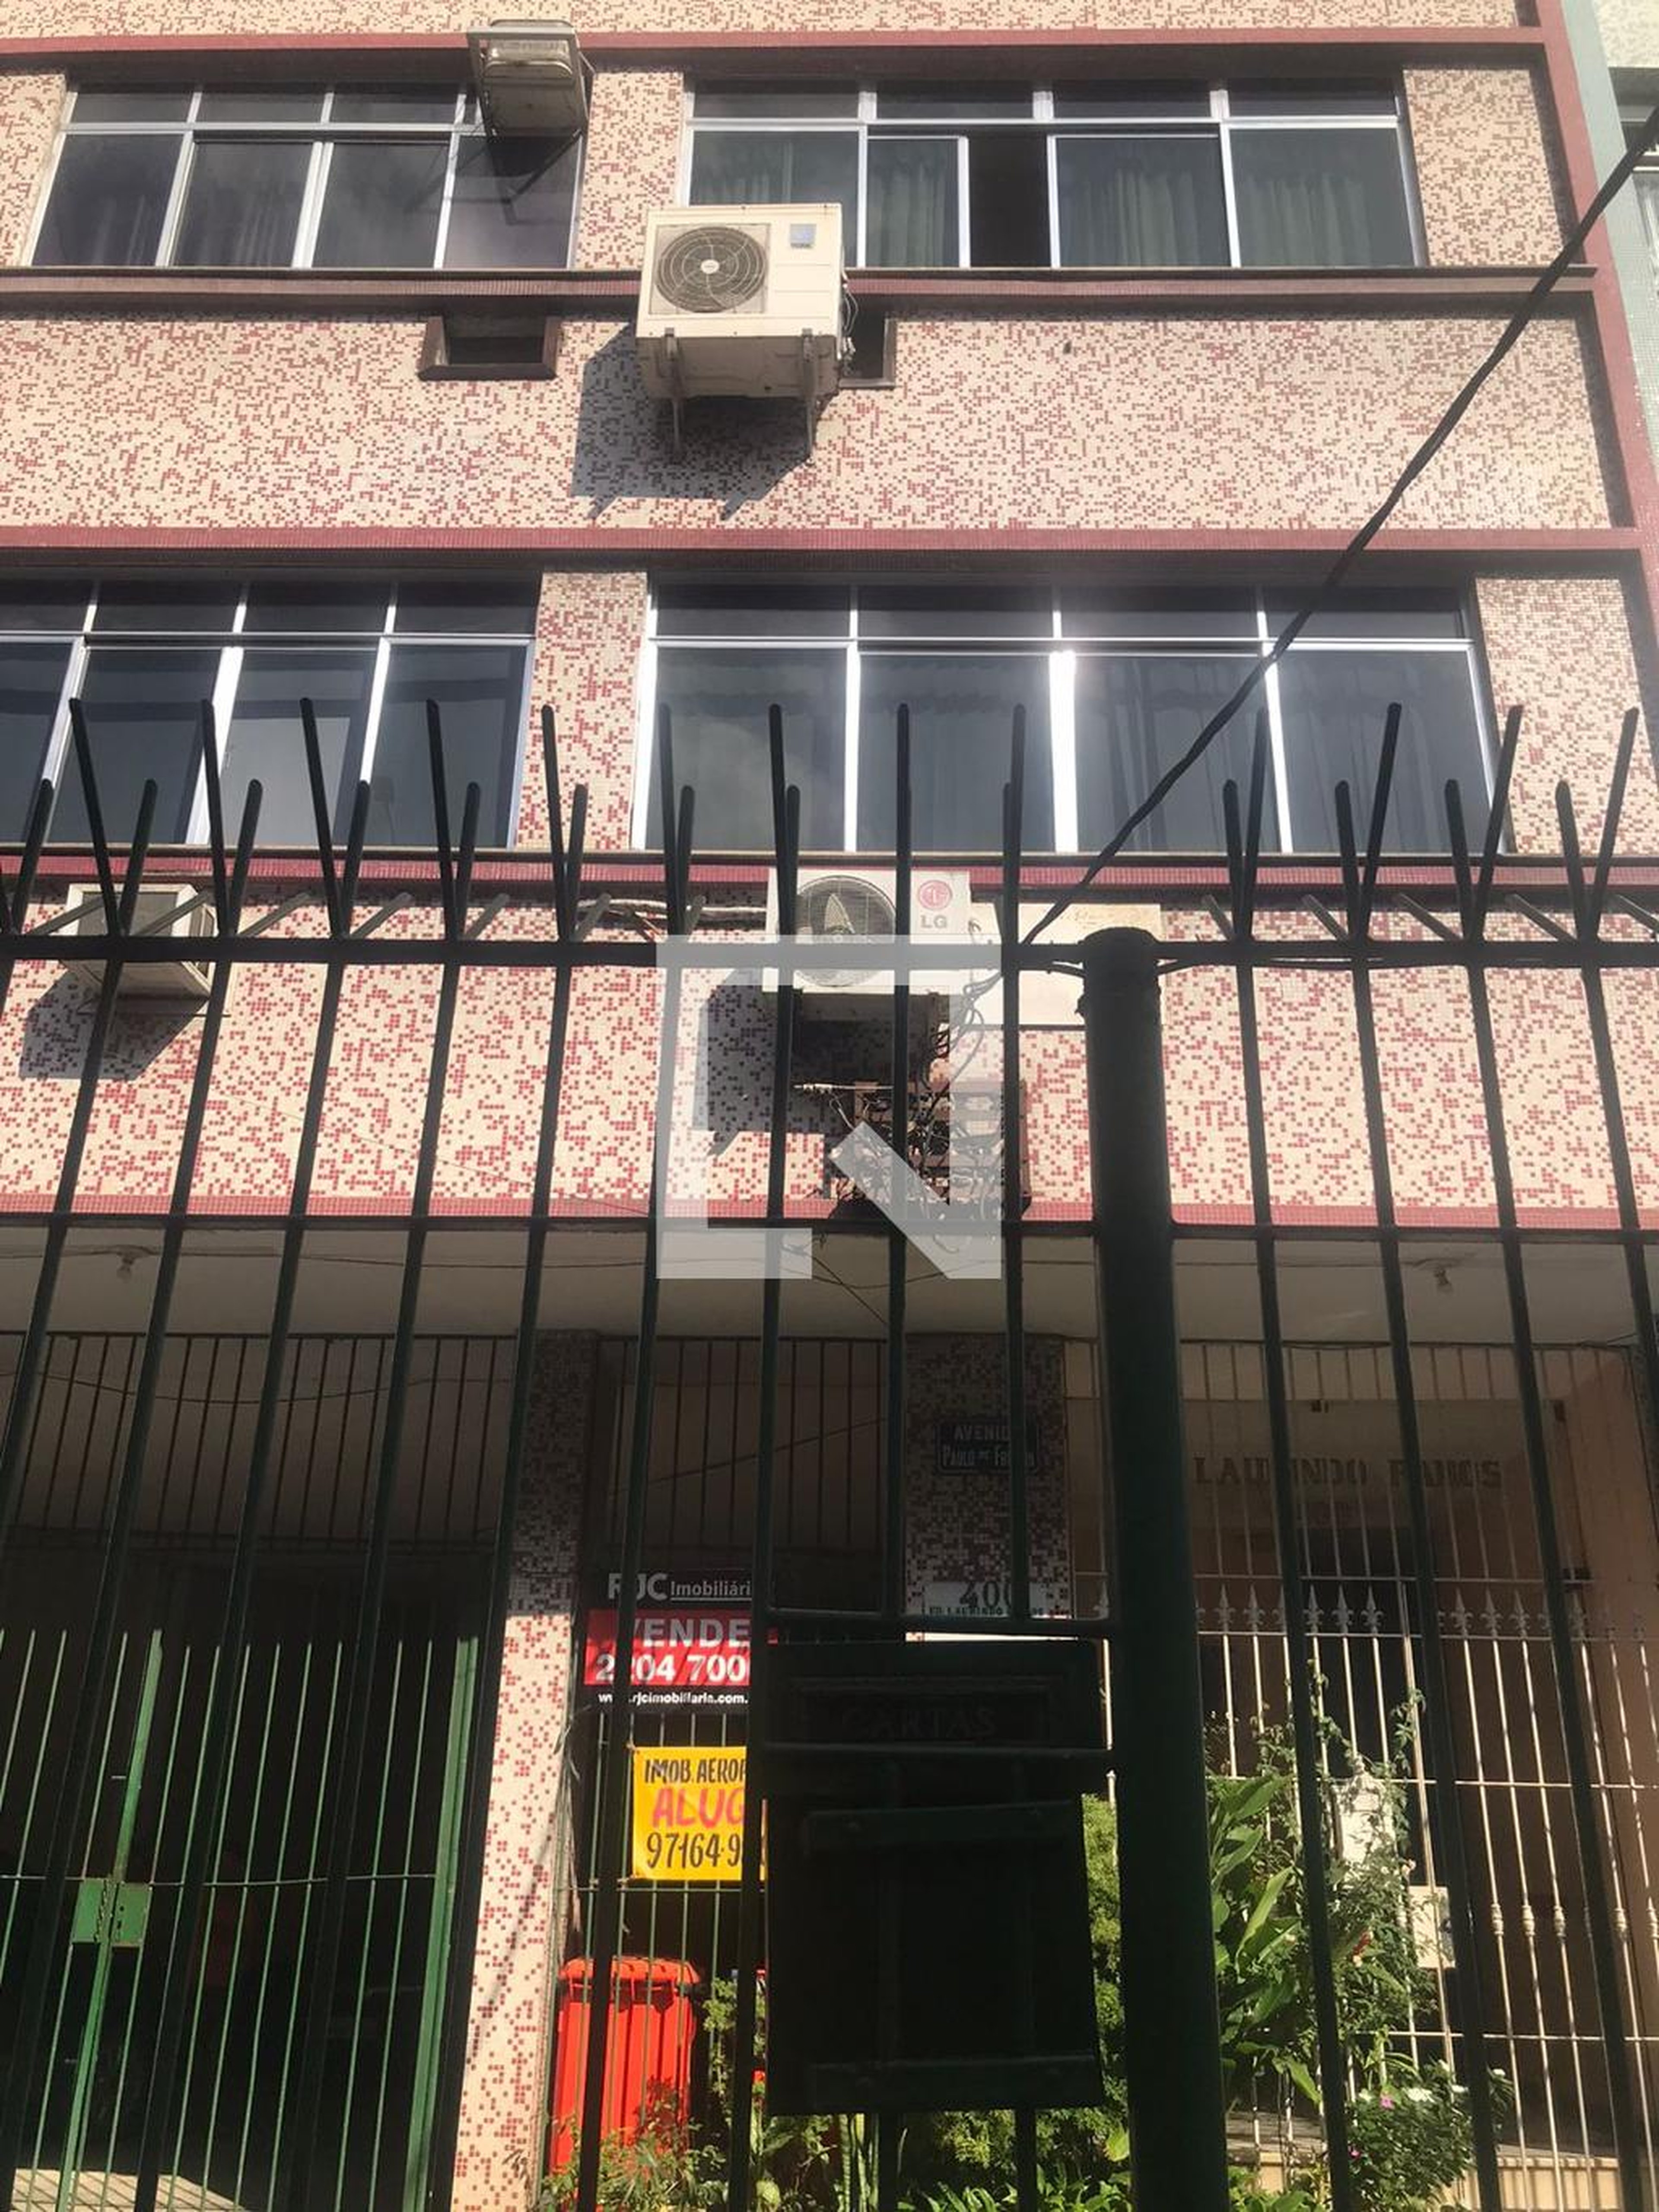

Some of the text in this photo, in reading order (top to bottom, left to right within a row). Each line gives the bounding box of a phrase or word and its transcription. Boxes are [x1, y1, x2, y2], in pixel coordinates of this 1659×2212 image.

[921, 915, 947, 929] LG
[954, 1425, 1010, 1440] AVENID
[1192, 1457, 1368, 1485] LAUINDO
[671, 1580, 751, 1596] Imobiliári
[596, 1654, 676, 1682] 204
